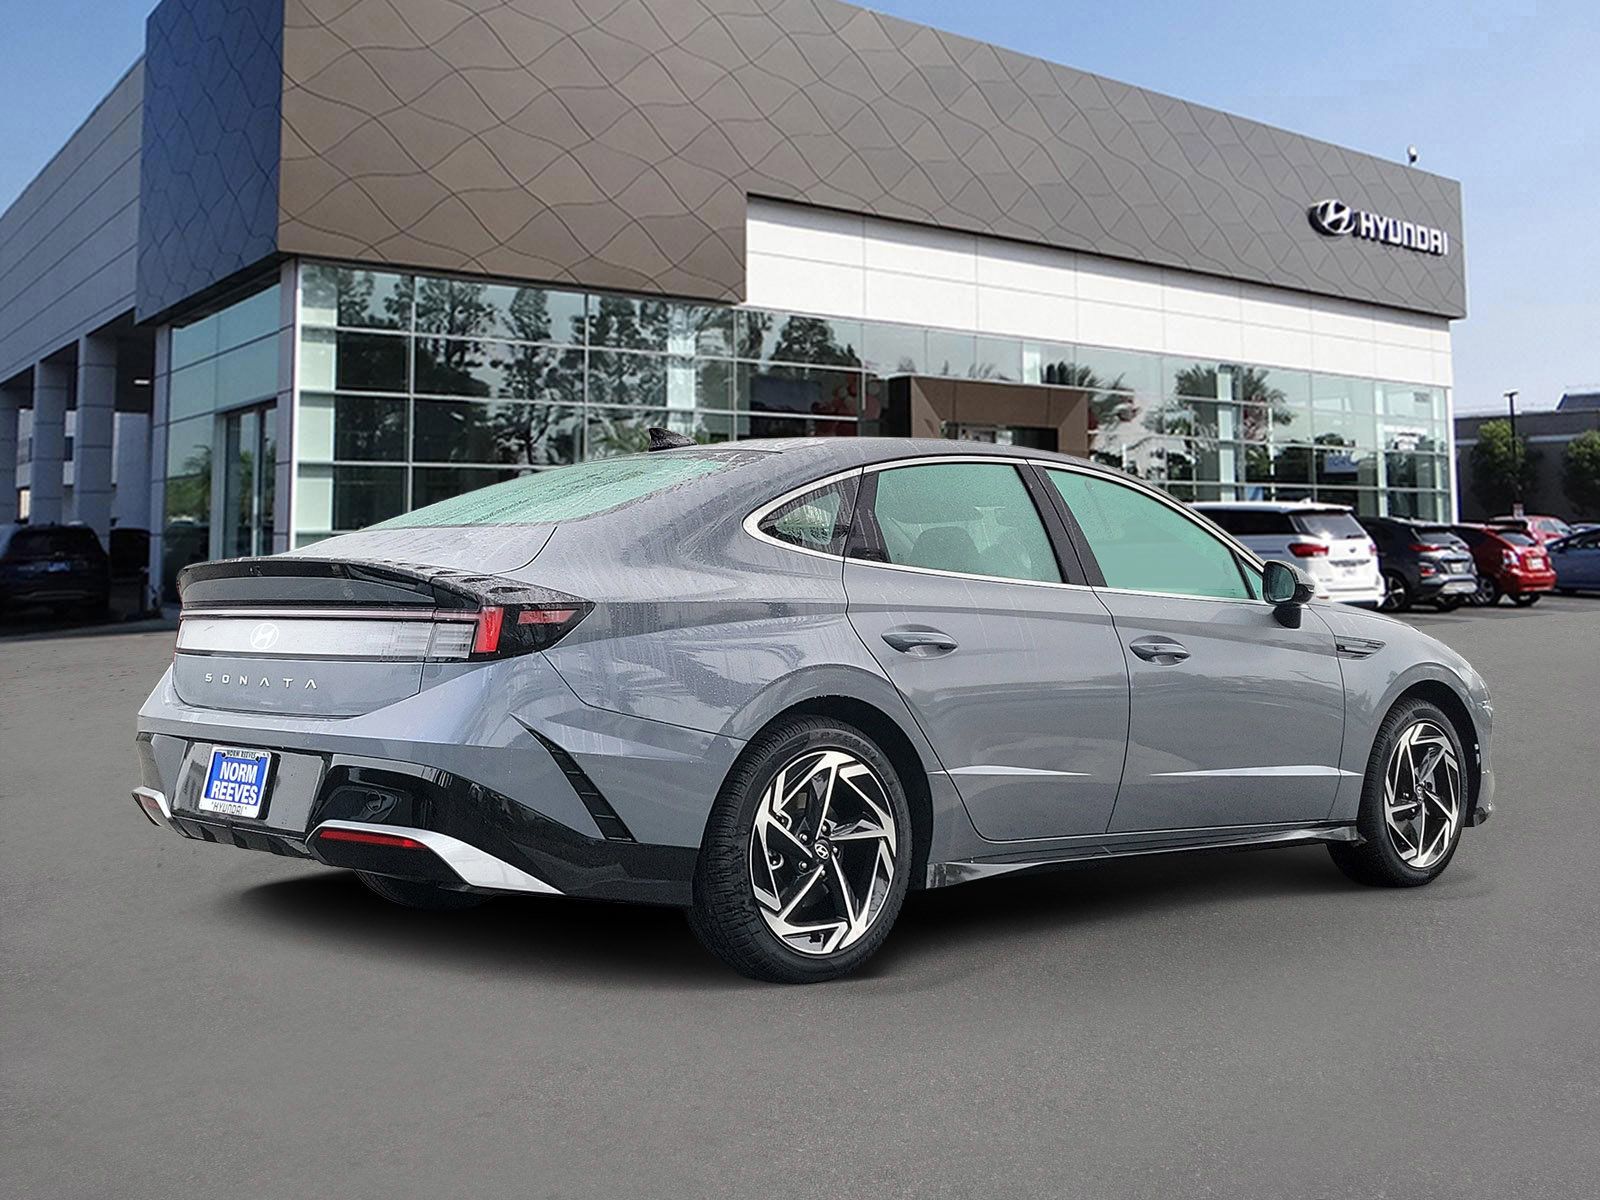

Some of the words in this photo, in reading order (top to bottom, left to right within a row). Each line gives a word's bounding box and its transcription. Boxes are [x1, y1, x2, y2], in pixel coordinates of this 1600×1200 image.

[1360, 211, 1448, 255] HYUNDAI
[205, 673, 317, 689] SONATA
[219, 761, 259, 784] NORM
[210, 780, 259, 805] REEVES
[213, 802, 244, 815] HYUNDAI
